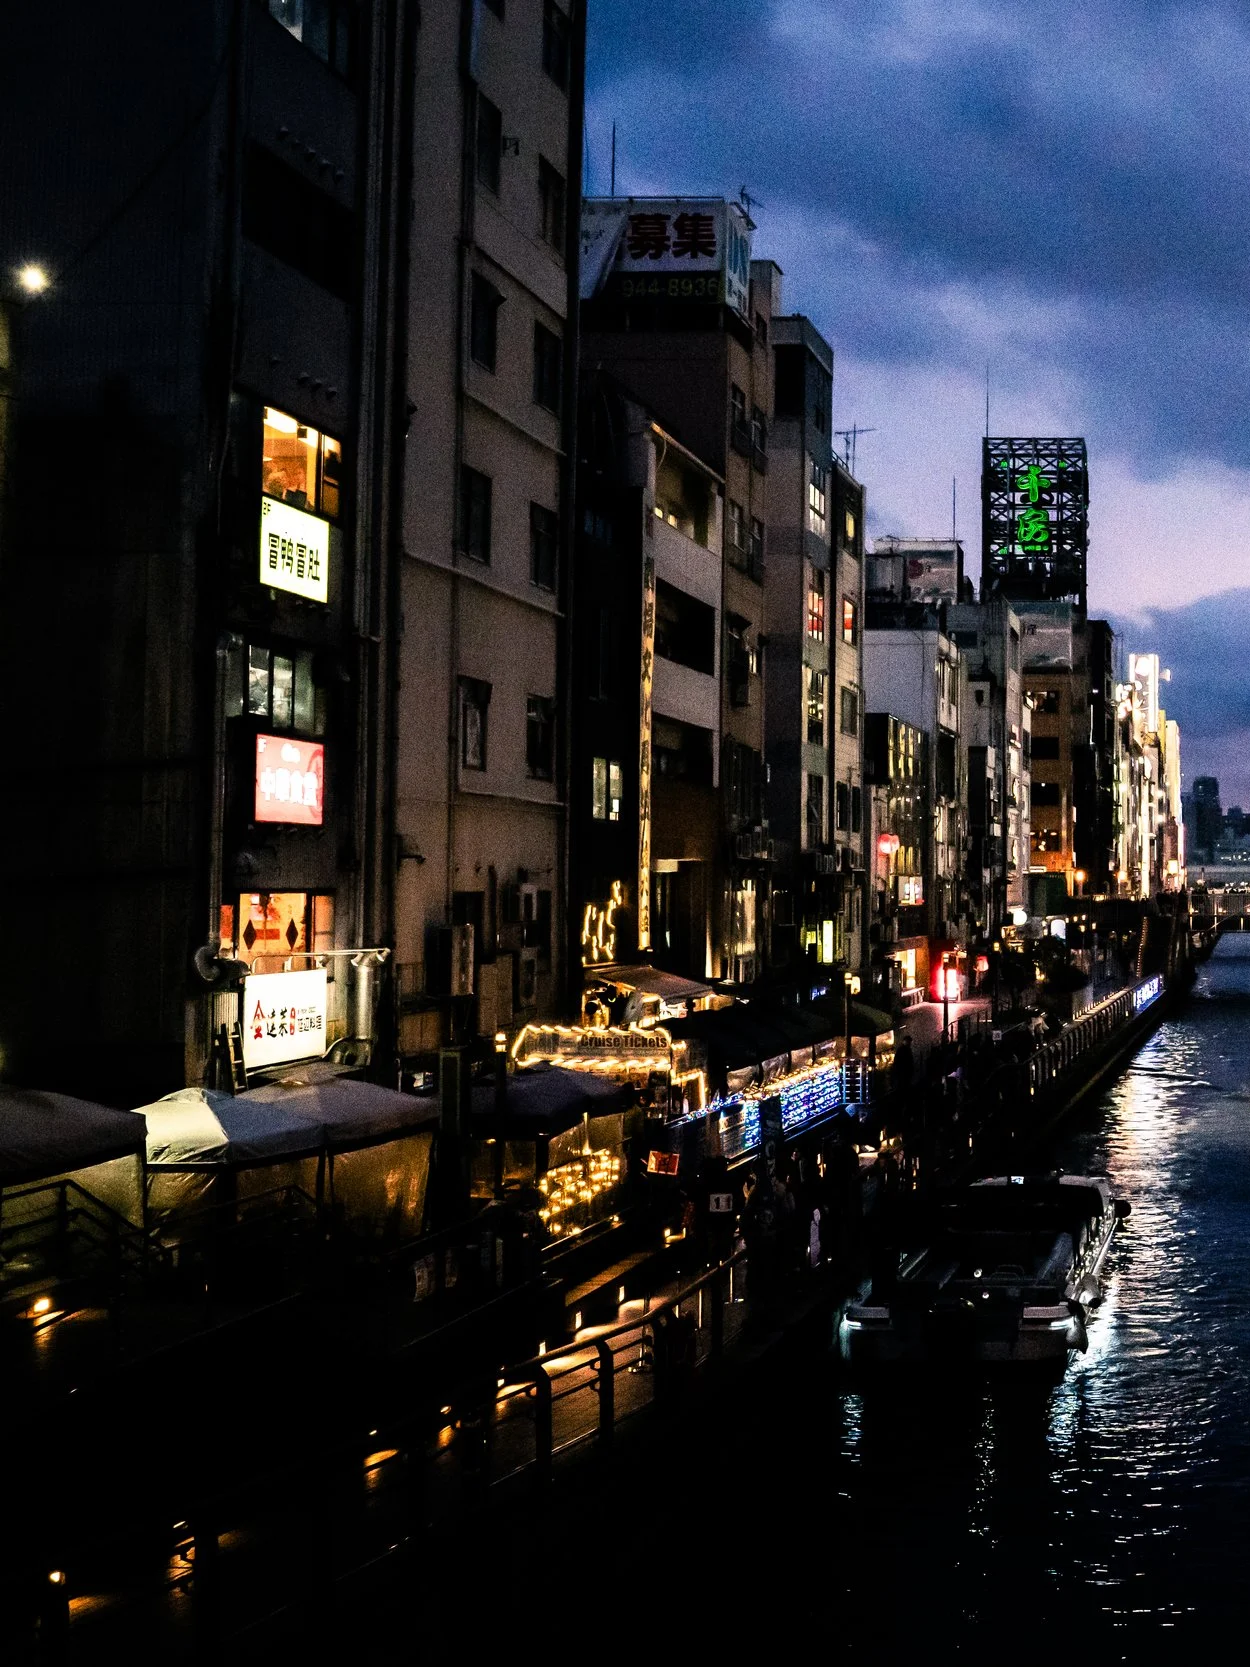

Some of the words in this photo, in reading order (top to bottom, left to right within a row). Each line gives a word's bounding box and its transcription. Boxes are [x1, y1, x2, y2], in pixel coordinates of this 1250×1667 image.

[627, 213, 717, 260] 募集
[580, 1034, 621, 1048] Cruise
[623, 1034, 668, 1048] Tickets
